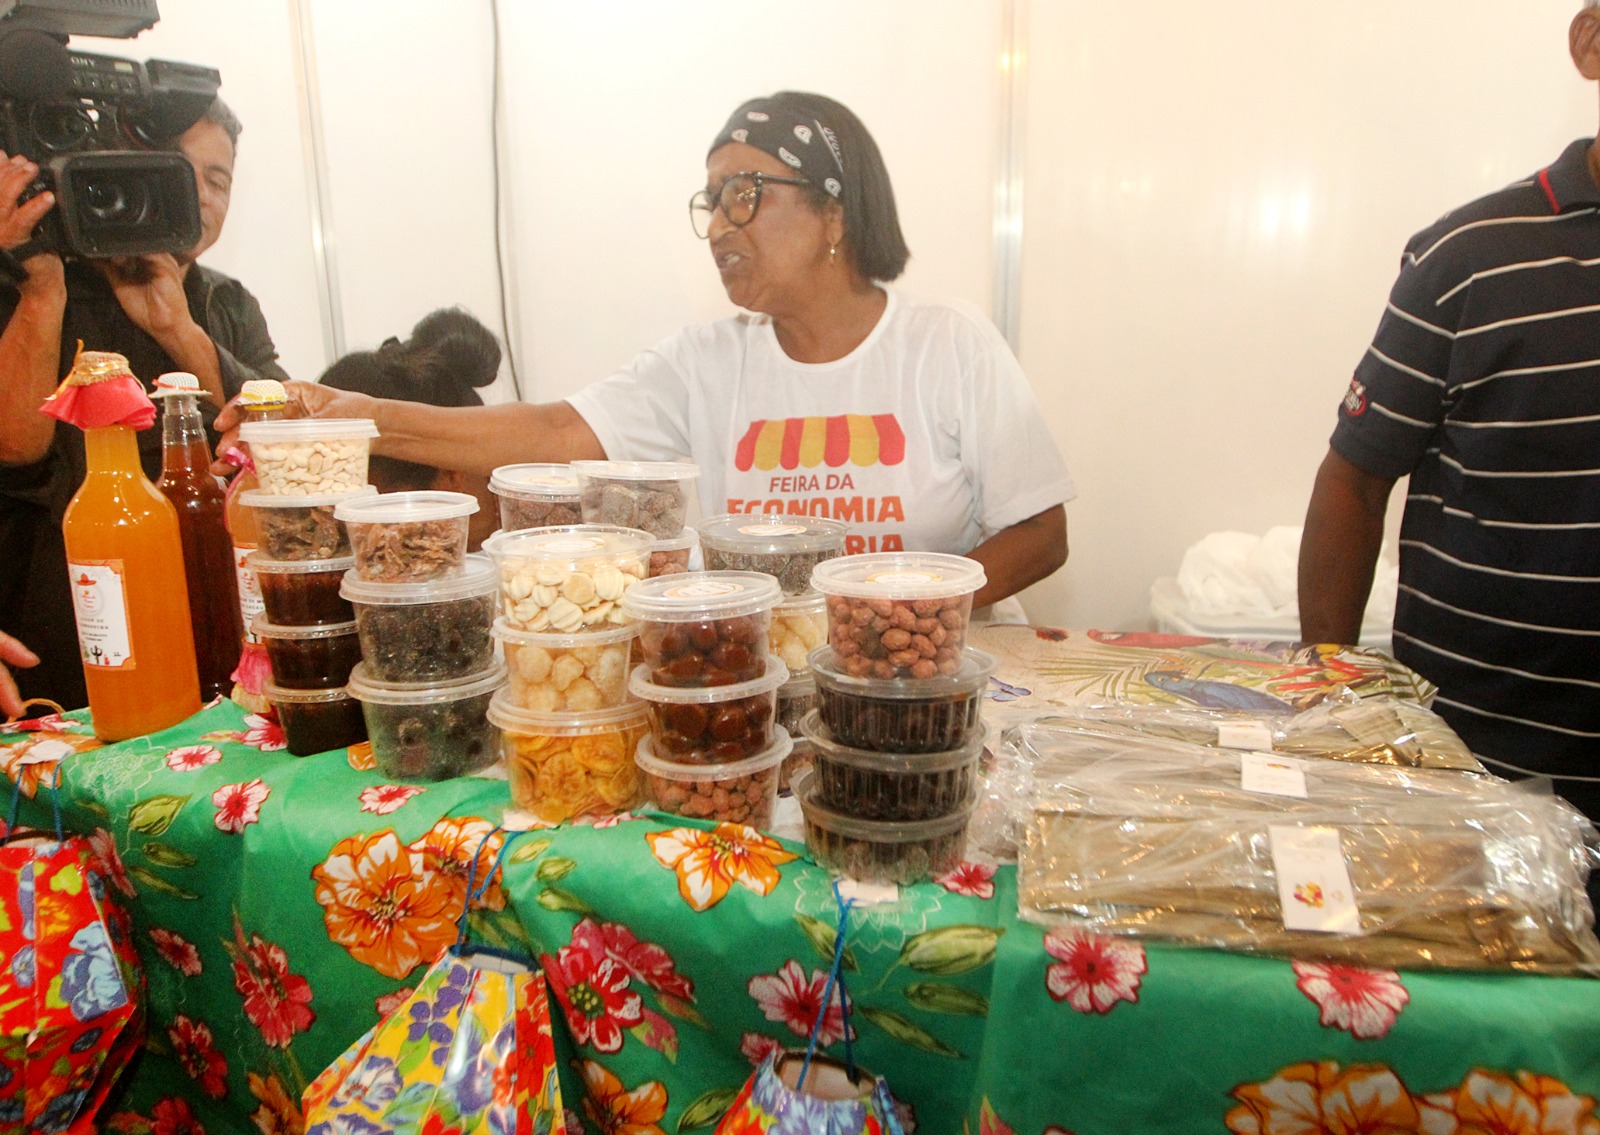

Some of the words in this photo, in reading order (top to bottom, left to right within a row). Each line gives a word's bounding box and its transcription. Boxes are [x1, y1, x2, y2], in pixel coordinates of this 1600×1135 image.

[70, 56, 95, 67] ONY
[769, 474, 820, 493] FEIRA
[825, 473, 855, 491] DA
[727, 496, 906, 523] ECONOMIA
